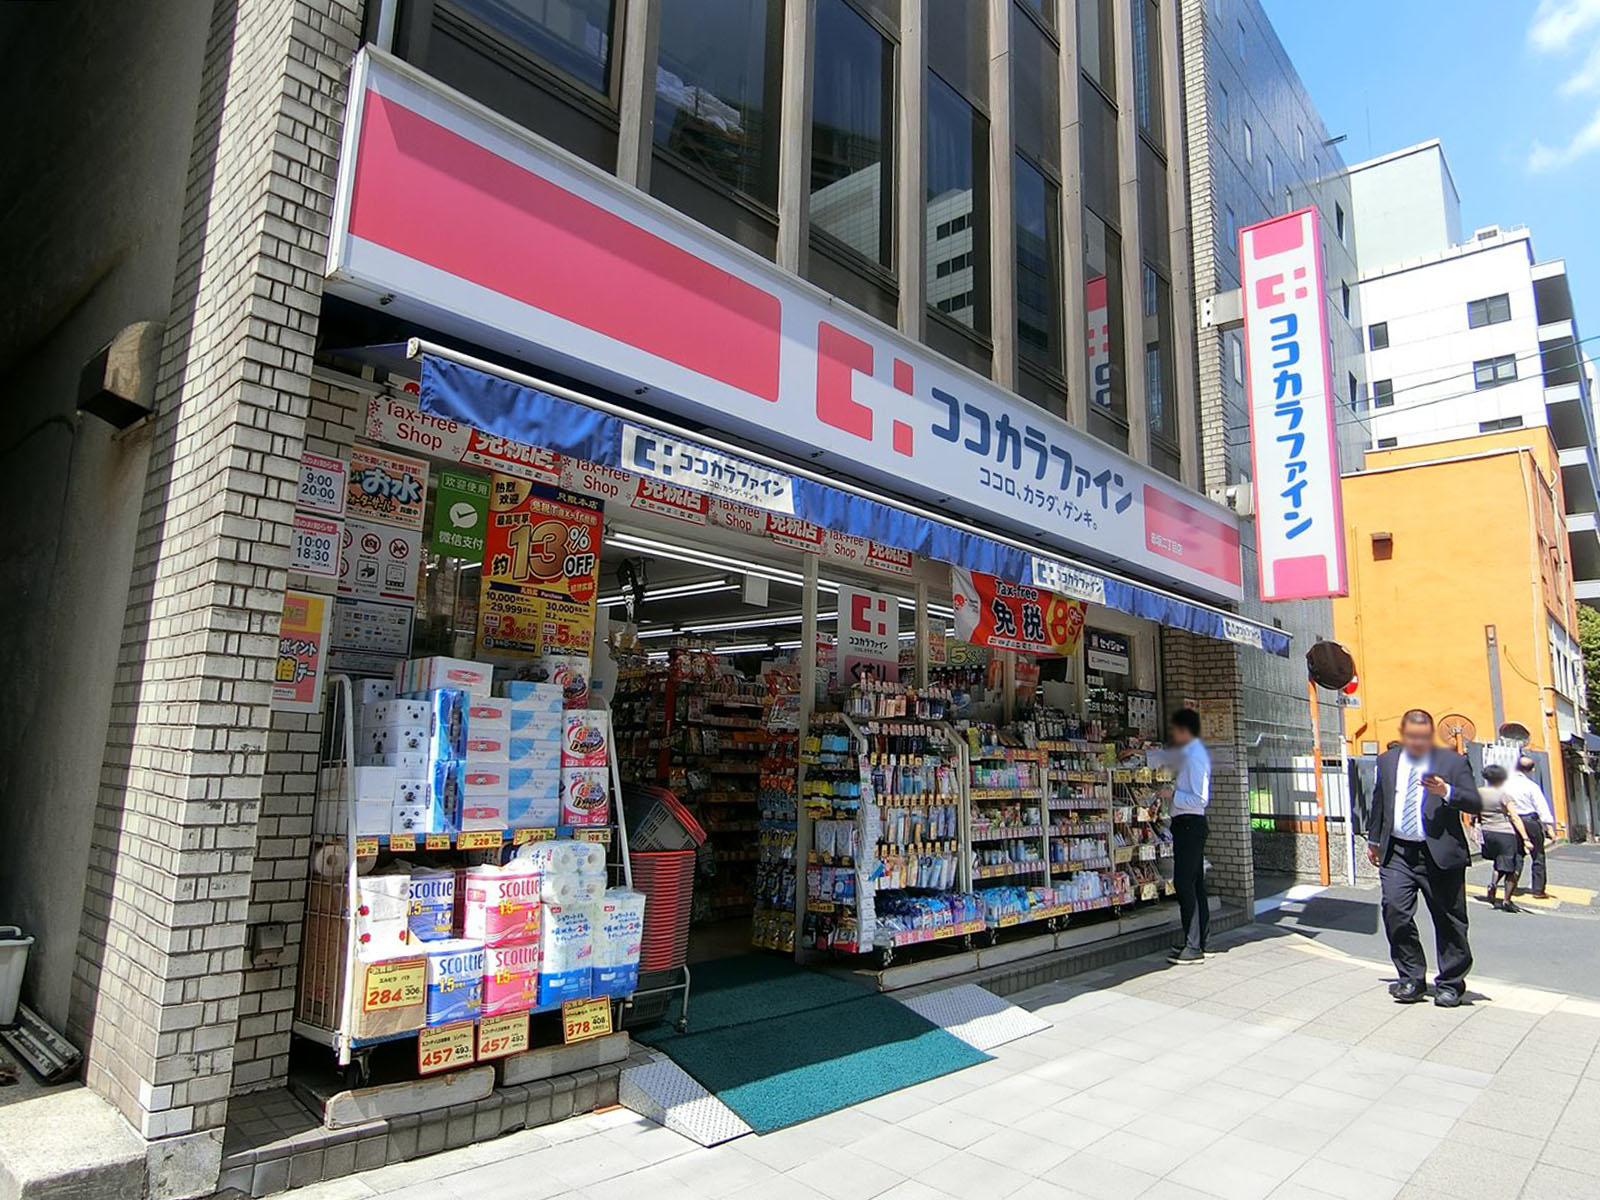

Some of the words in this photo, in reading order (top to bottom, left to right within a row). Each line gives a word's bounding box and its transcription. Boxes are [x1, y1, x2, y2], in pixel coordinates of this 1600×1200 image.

[386, 401, 458, 434] Tax-Free
[1270, 313, 1313, 540] ココカラファイン
[396, 423, 443, 450] Shop
[931, 386, 1132, 514] ココカラファイン
[301, 455, 339, 470] のお知らせ
[306, 472, 333, 488] 9:00
[680, 453, 785, 497] ココカラファイン
[301, 483, 335, 500] 20:00
[583, 474, 619, 497] Shop
[979, 467, 1100, 530] ココロ、カラダ、ゲンキ。
[718, 499, 760, 519] Tax-Free
[295, 519, 334, 533] のお知らせ
[725, 513, 752, 531] Shop
[298, 535, 331, 550] 10:00
[439, 530, 484, 551] 微信支付
[296, 547, 329, 562] 18:30
[834, 543, 856, 559] Shop
[564, 553, 595, 577] OFF
[995, 580, 1038, 600] Tax-free
[992, 598, 1044, 641] 免税
[280, 638, 318, 657] ポイント
[849, 636, 889, 650] ココカラファイン
[367, 988, 402, 1006] 284
[405, 987, 420, 996] 306
[567, 1020, 590, 1037] 378
[480, 1036, 510, 1053] 457
[511, 1034, 524, 1042] 493
[422, 1047, 454, 1066] 457
[455, 1045, 469, 1054] 493
